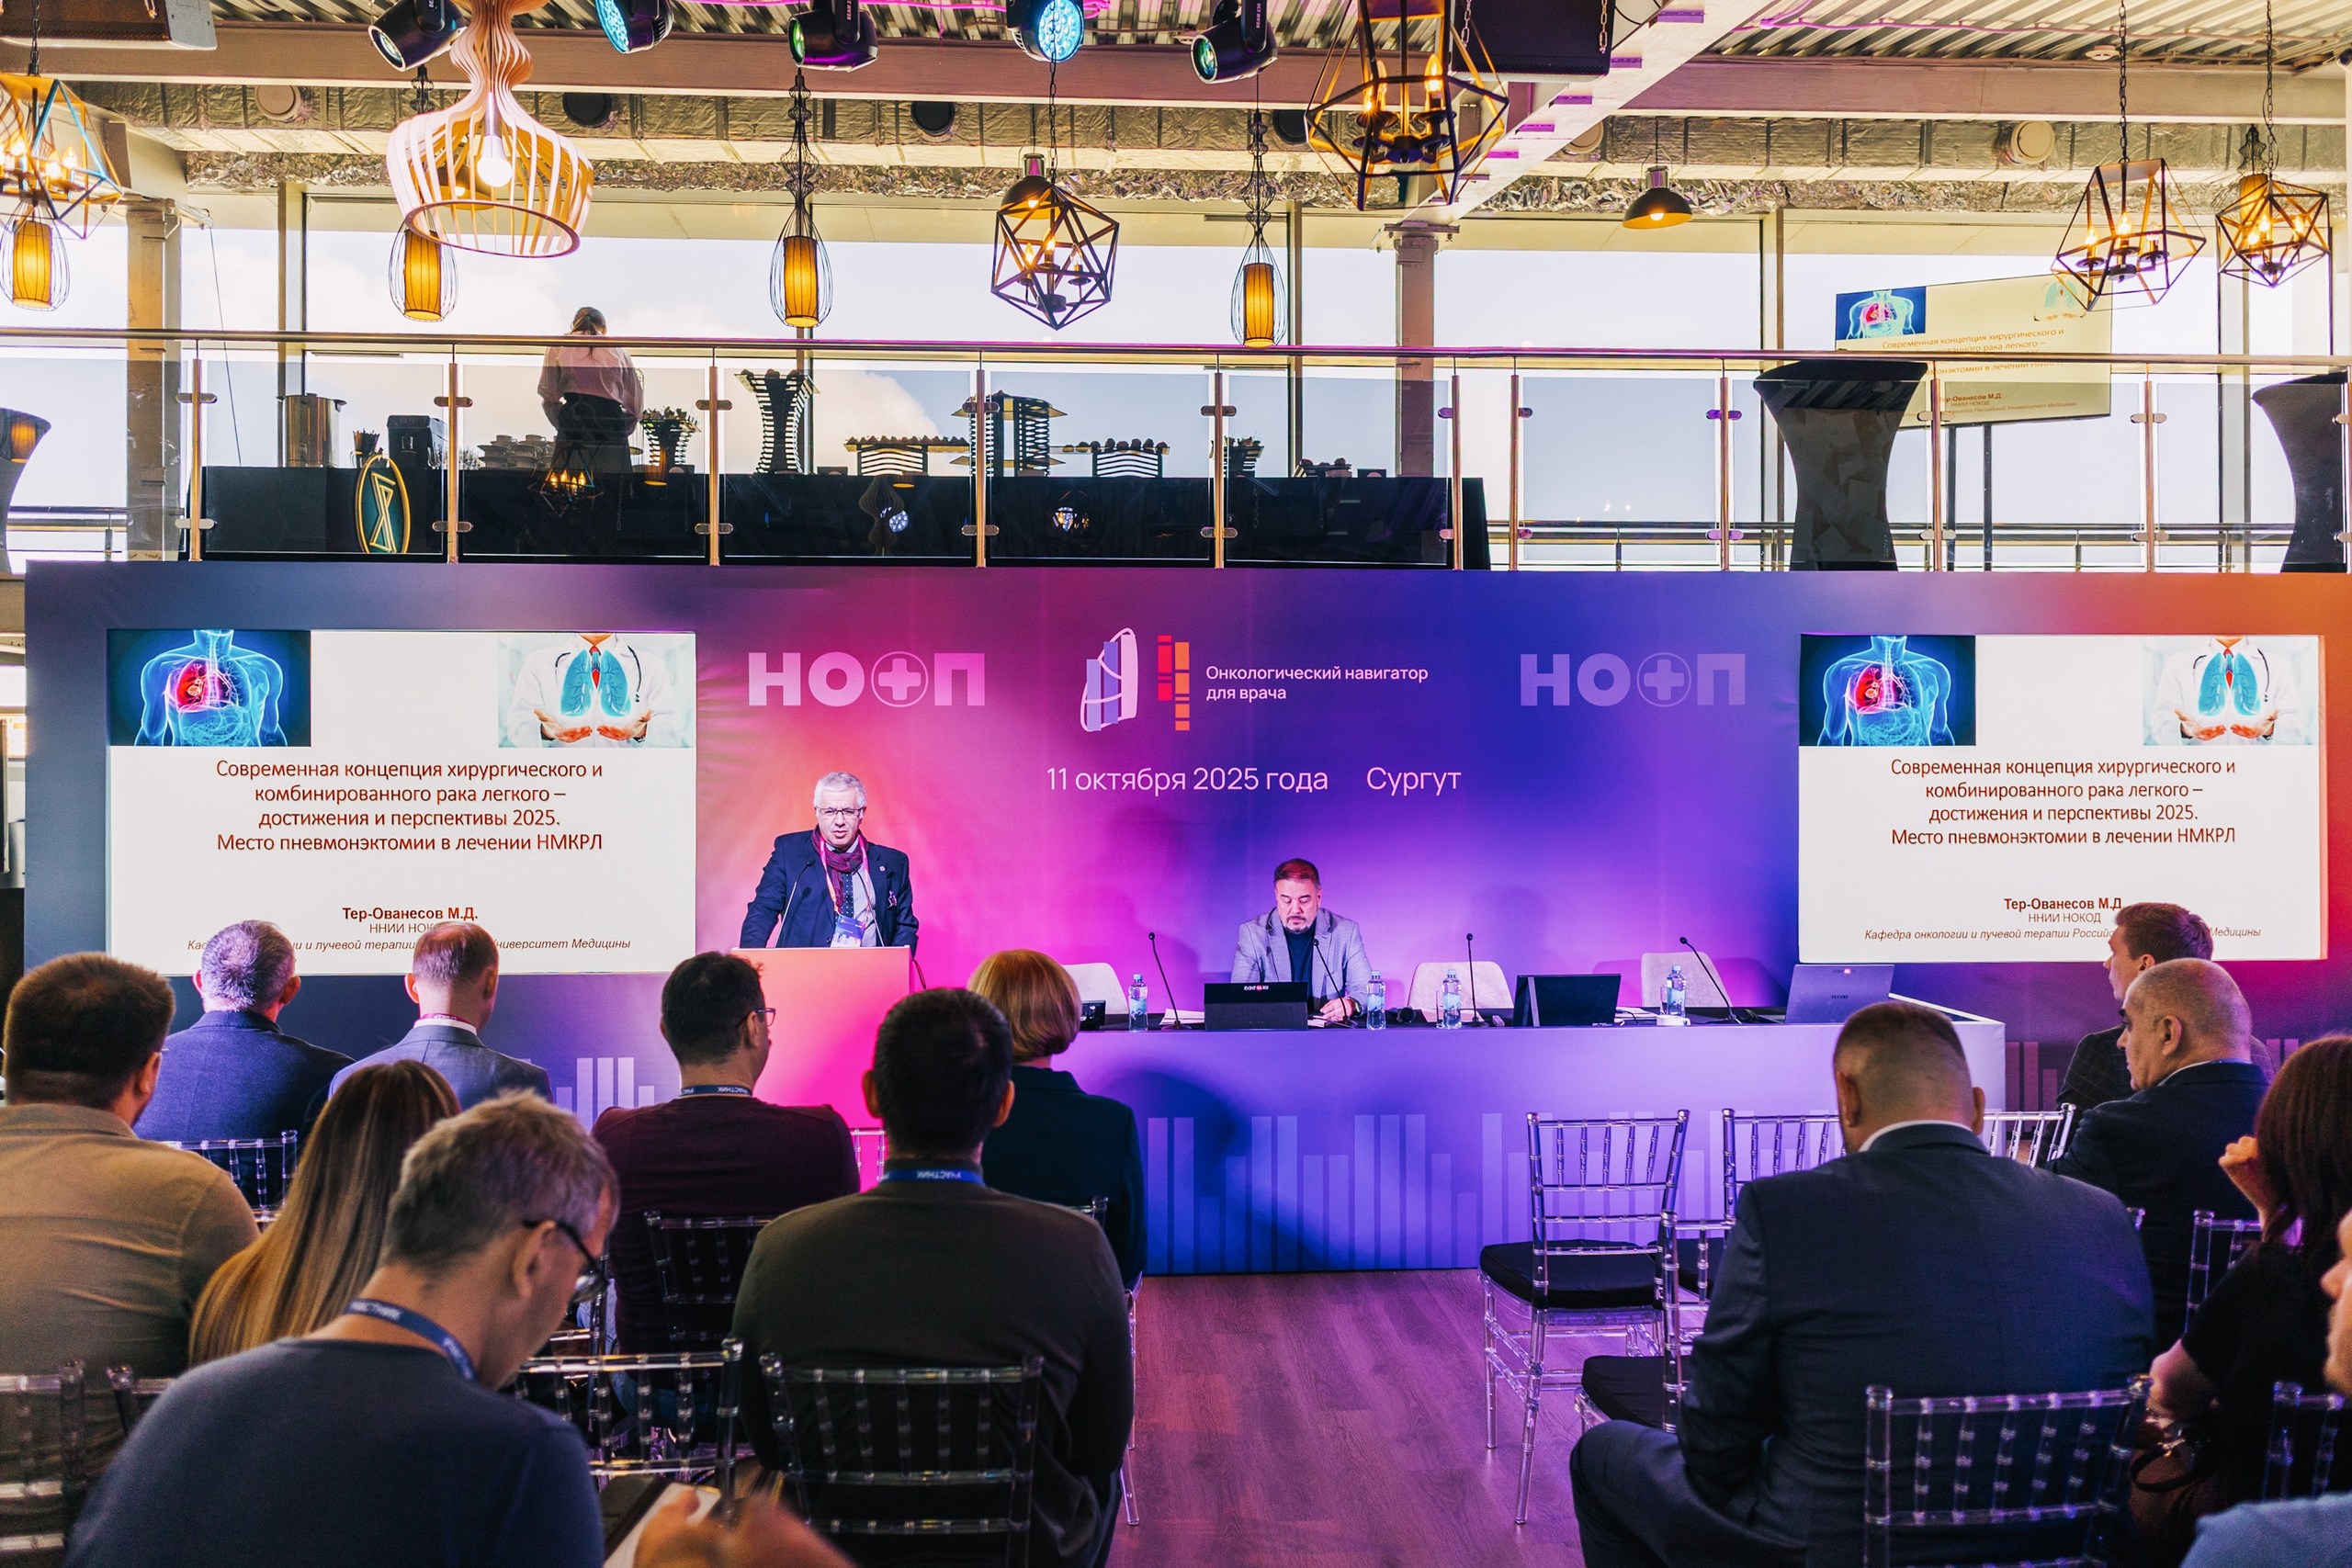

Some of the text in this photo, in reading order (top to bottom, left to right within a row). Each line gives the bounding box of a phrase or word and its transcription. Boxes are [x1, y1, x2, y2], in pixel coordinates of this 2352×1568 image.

[1882, 338, 1939, 350] Современная
[1939, 334, 1986, 346] концепция
[1989, 329, 2057, 341] хирургического
[2005, 341, 2039, 350] легкого
[1205, 665, 1429, 682] Онкологический навигатор
[1205, 688, 1287, 704] для врача
[216, 760, 603, 781] Современная концепция хирургического и
[1891, 759, 2235, 778] Современная концепция хирургического и
[1046, 766, 1463, 797] 11 октября 2025 года Сургут
[254, 784, 432, 806] комбинированного
[436, 788, 478, 806] рака
[481, 788, 550, 802] легкого
[1925, 781, 2084, 801] комбинированного
[2087, 784, 2124, 801] рака
[2128, 784, 2189, 797] легкого
[258, 808, 561, 829] достижения и перспективы 2025.
[1928, 804, 2199, 824] достижения и перспективы 2025.
[217, 833, 603, 851] Место пневмонэктомии в лечении НМКРЛ
[1892, 827, 2235, 844] Место пневмонэктомии в лечении НМКРЛ
[2003, 897, 2122, 912] Тер-Ованесов М.Д
[341, 906, 479, 922] Тер-Ованесов М.Д.
[2028, 912, 2102, 924] ННИИ НОКОД
[369, 922, 405, 934] ННИИ
[1864, 929, 1912, 942] Кафедра
[1914, 931, 1968, 940] онкологии
[1970, 931, 1978, 939] и
[1979, 929, 2022, 942] лучевой
[2023, 930, 2070, 941] терапии
[305, 941, 313, 951] и
[314, 939, 362, 953] лучевой
[364, 941, 415, 953] терапии
[496, 938, 631, 951] ниверситет Медицины
